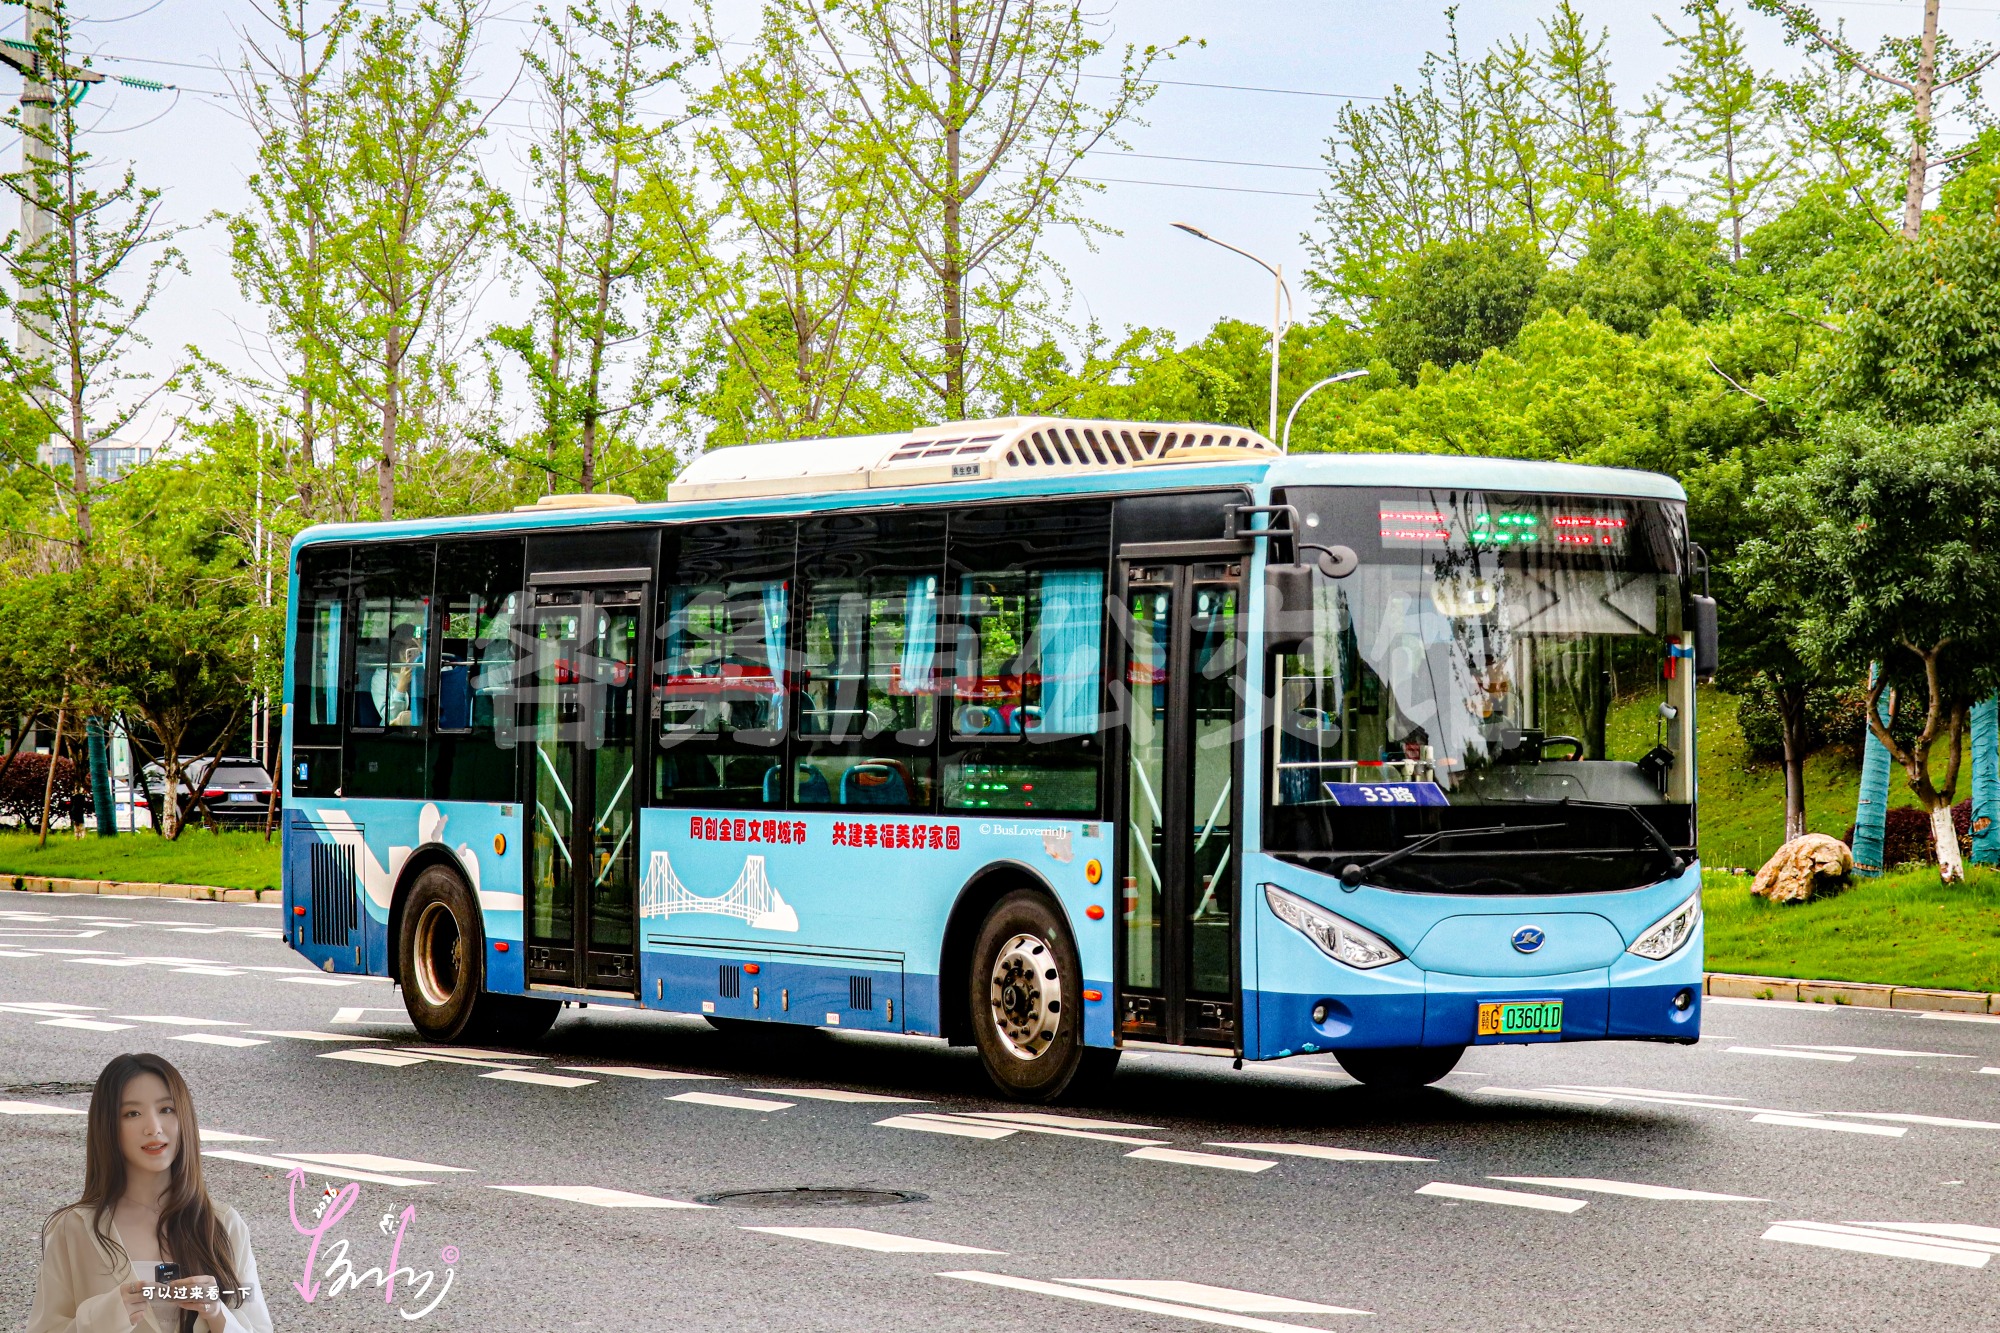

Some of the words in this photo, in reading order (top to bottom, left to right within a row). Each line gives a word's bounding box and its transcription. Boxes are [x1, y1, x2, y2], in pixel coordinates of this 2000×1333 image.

[1359, 786, 1416, 803] 33路
[690, 816, 807, 845] 同创全国文明城市
[832, 821, 960, 850] 共建幸福美好家园
